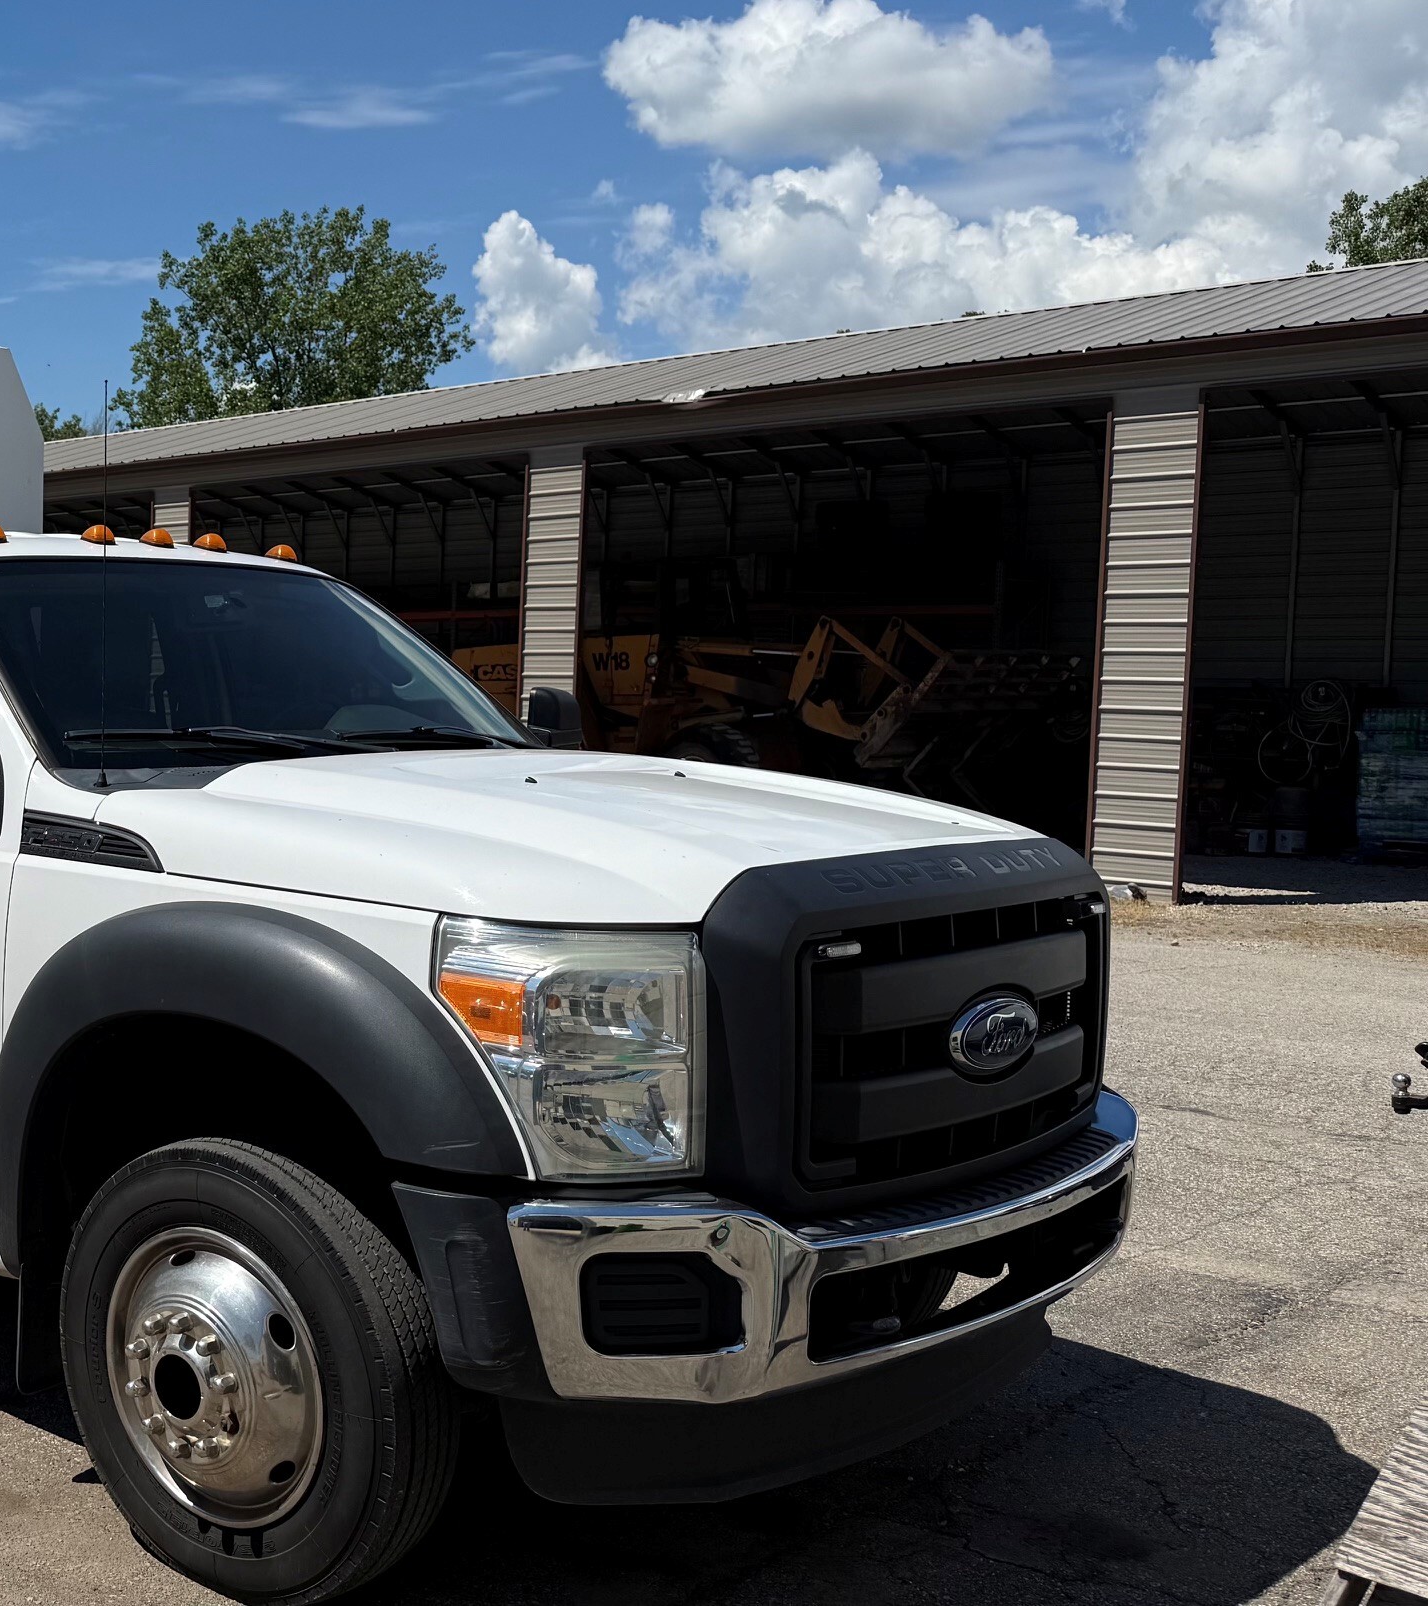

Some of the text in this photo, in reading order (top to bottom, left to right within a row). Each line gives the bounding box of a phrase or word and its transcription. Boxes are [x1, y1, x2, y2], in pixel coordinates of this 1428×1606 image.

[592, 651, 630, 671] W18
[819, 847, 1062, 895] SUPER DUTY
[981, 1012, 1028, 1057] Ford
